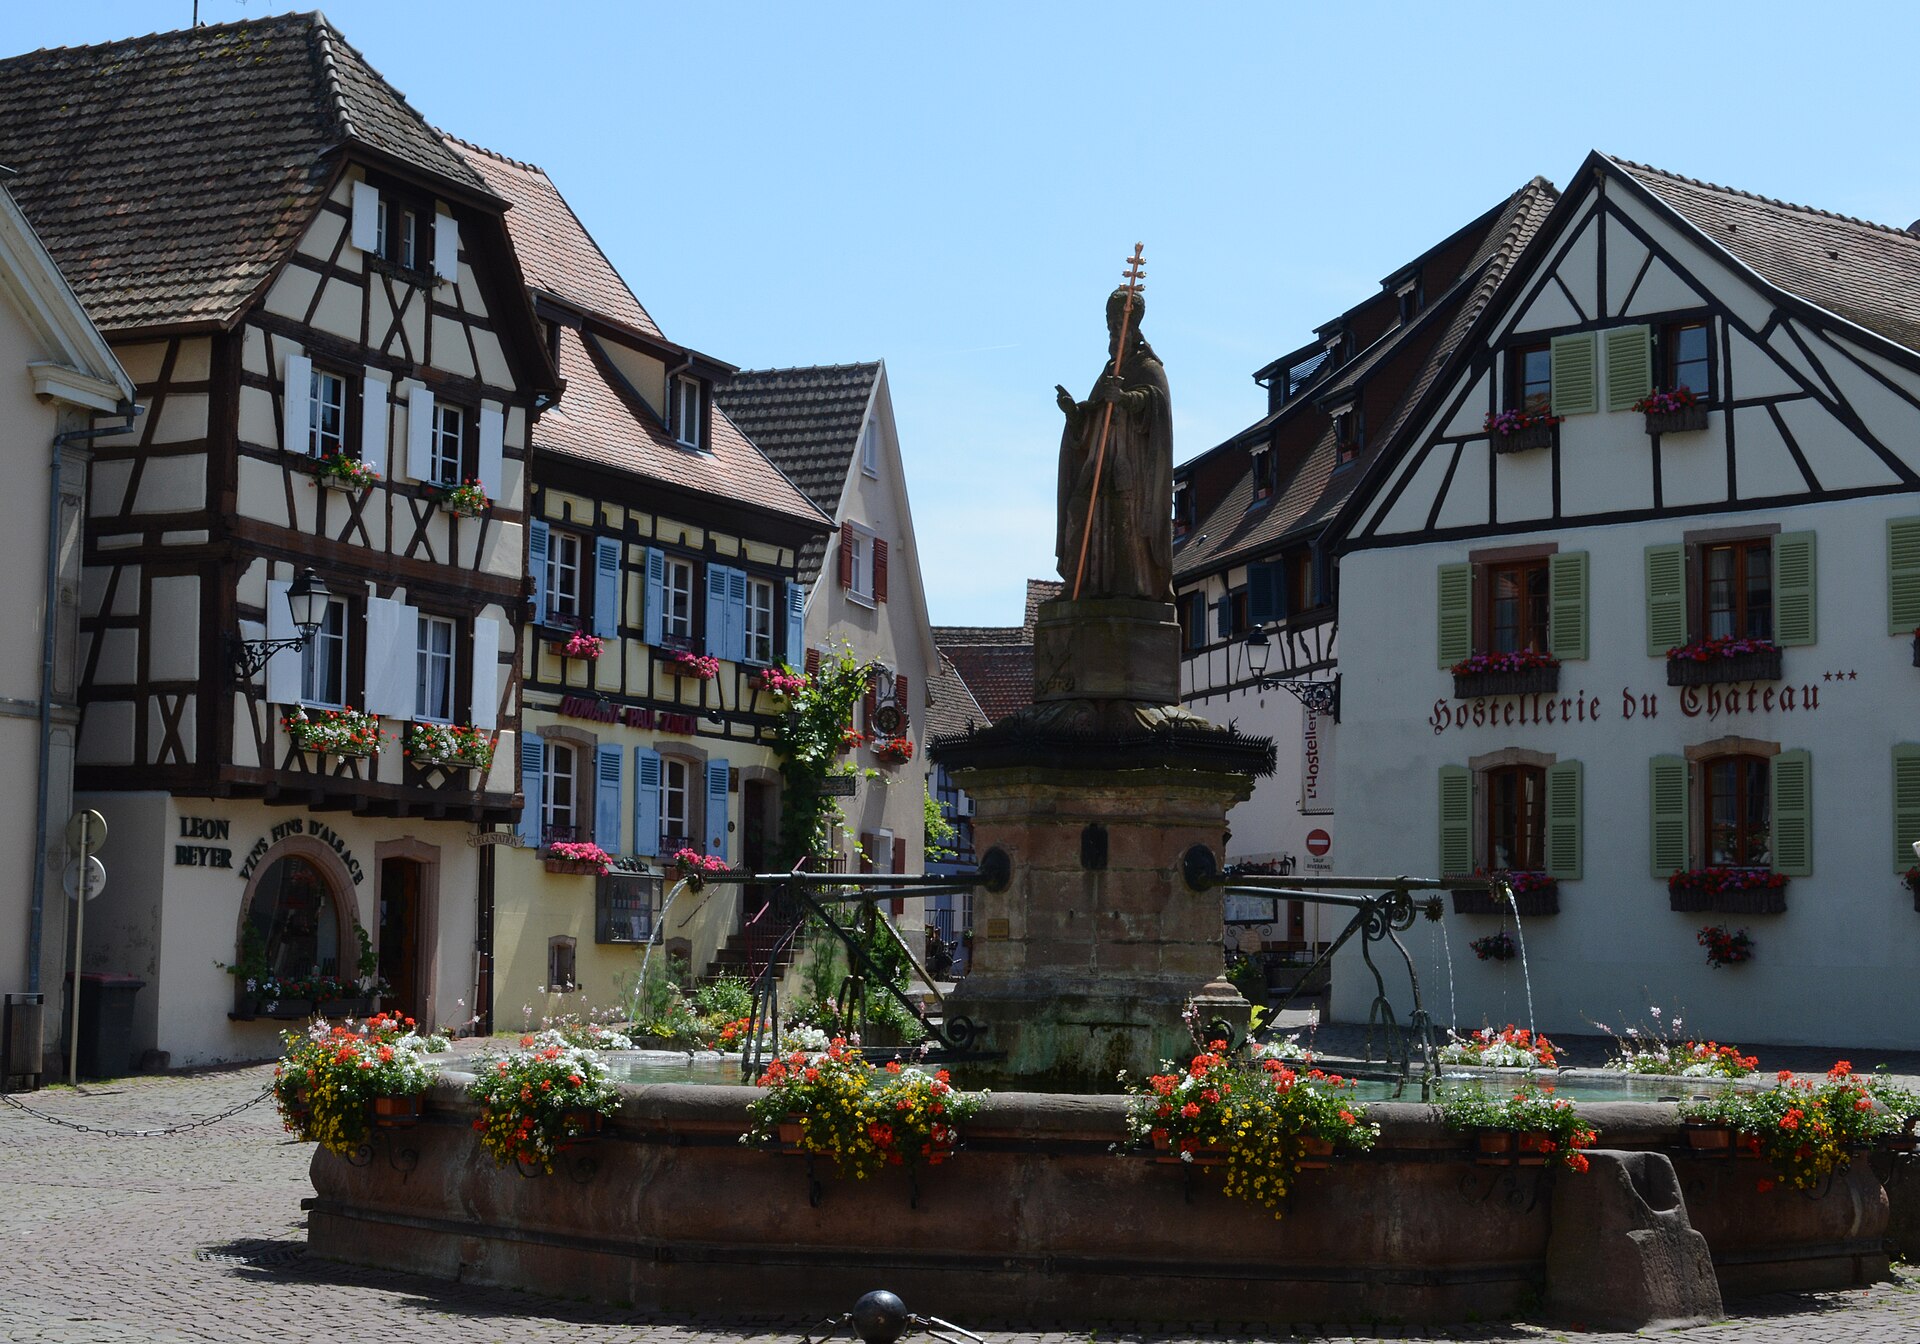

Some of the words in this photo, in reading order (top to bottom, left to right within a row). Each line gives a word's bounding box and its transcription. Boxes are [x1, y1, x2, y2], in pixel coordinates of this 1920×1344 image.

[1429, 690, 1600, 735] Hostellerie
[1622, 687, 1658, 721] du
[1680, 680, 1821, 722] Château
[179, 816, 231, 841] LEON
[174, 844, 233, 869] BEYER
[239, 837, 270, 882] VINS
[271, 818, 303, 843] FINS
[309, 820, 365, 886] D'ALSACE
